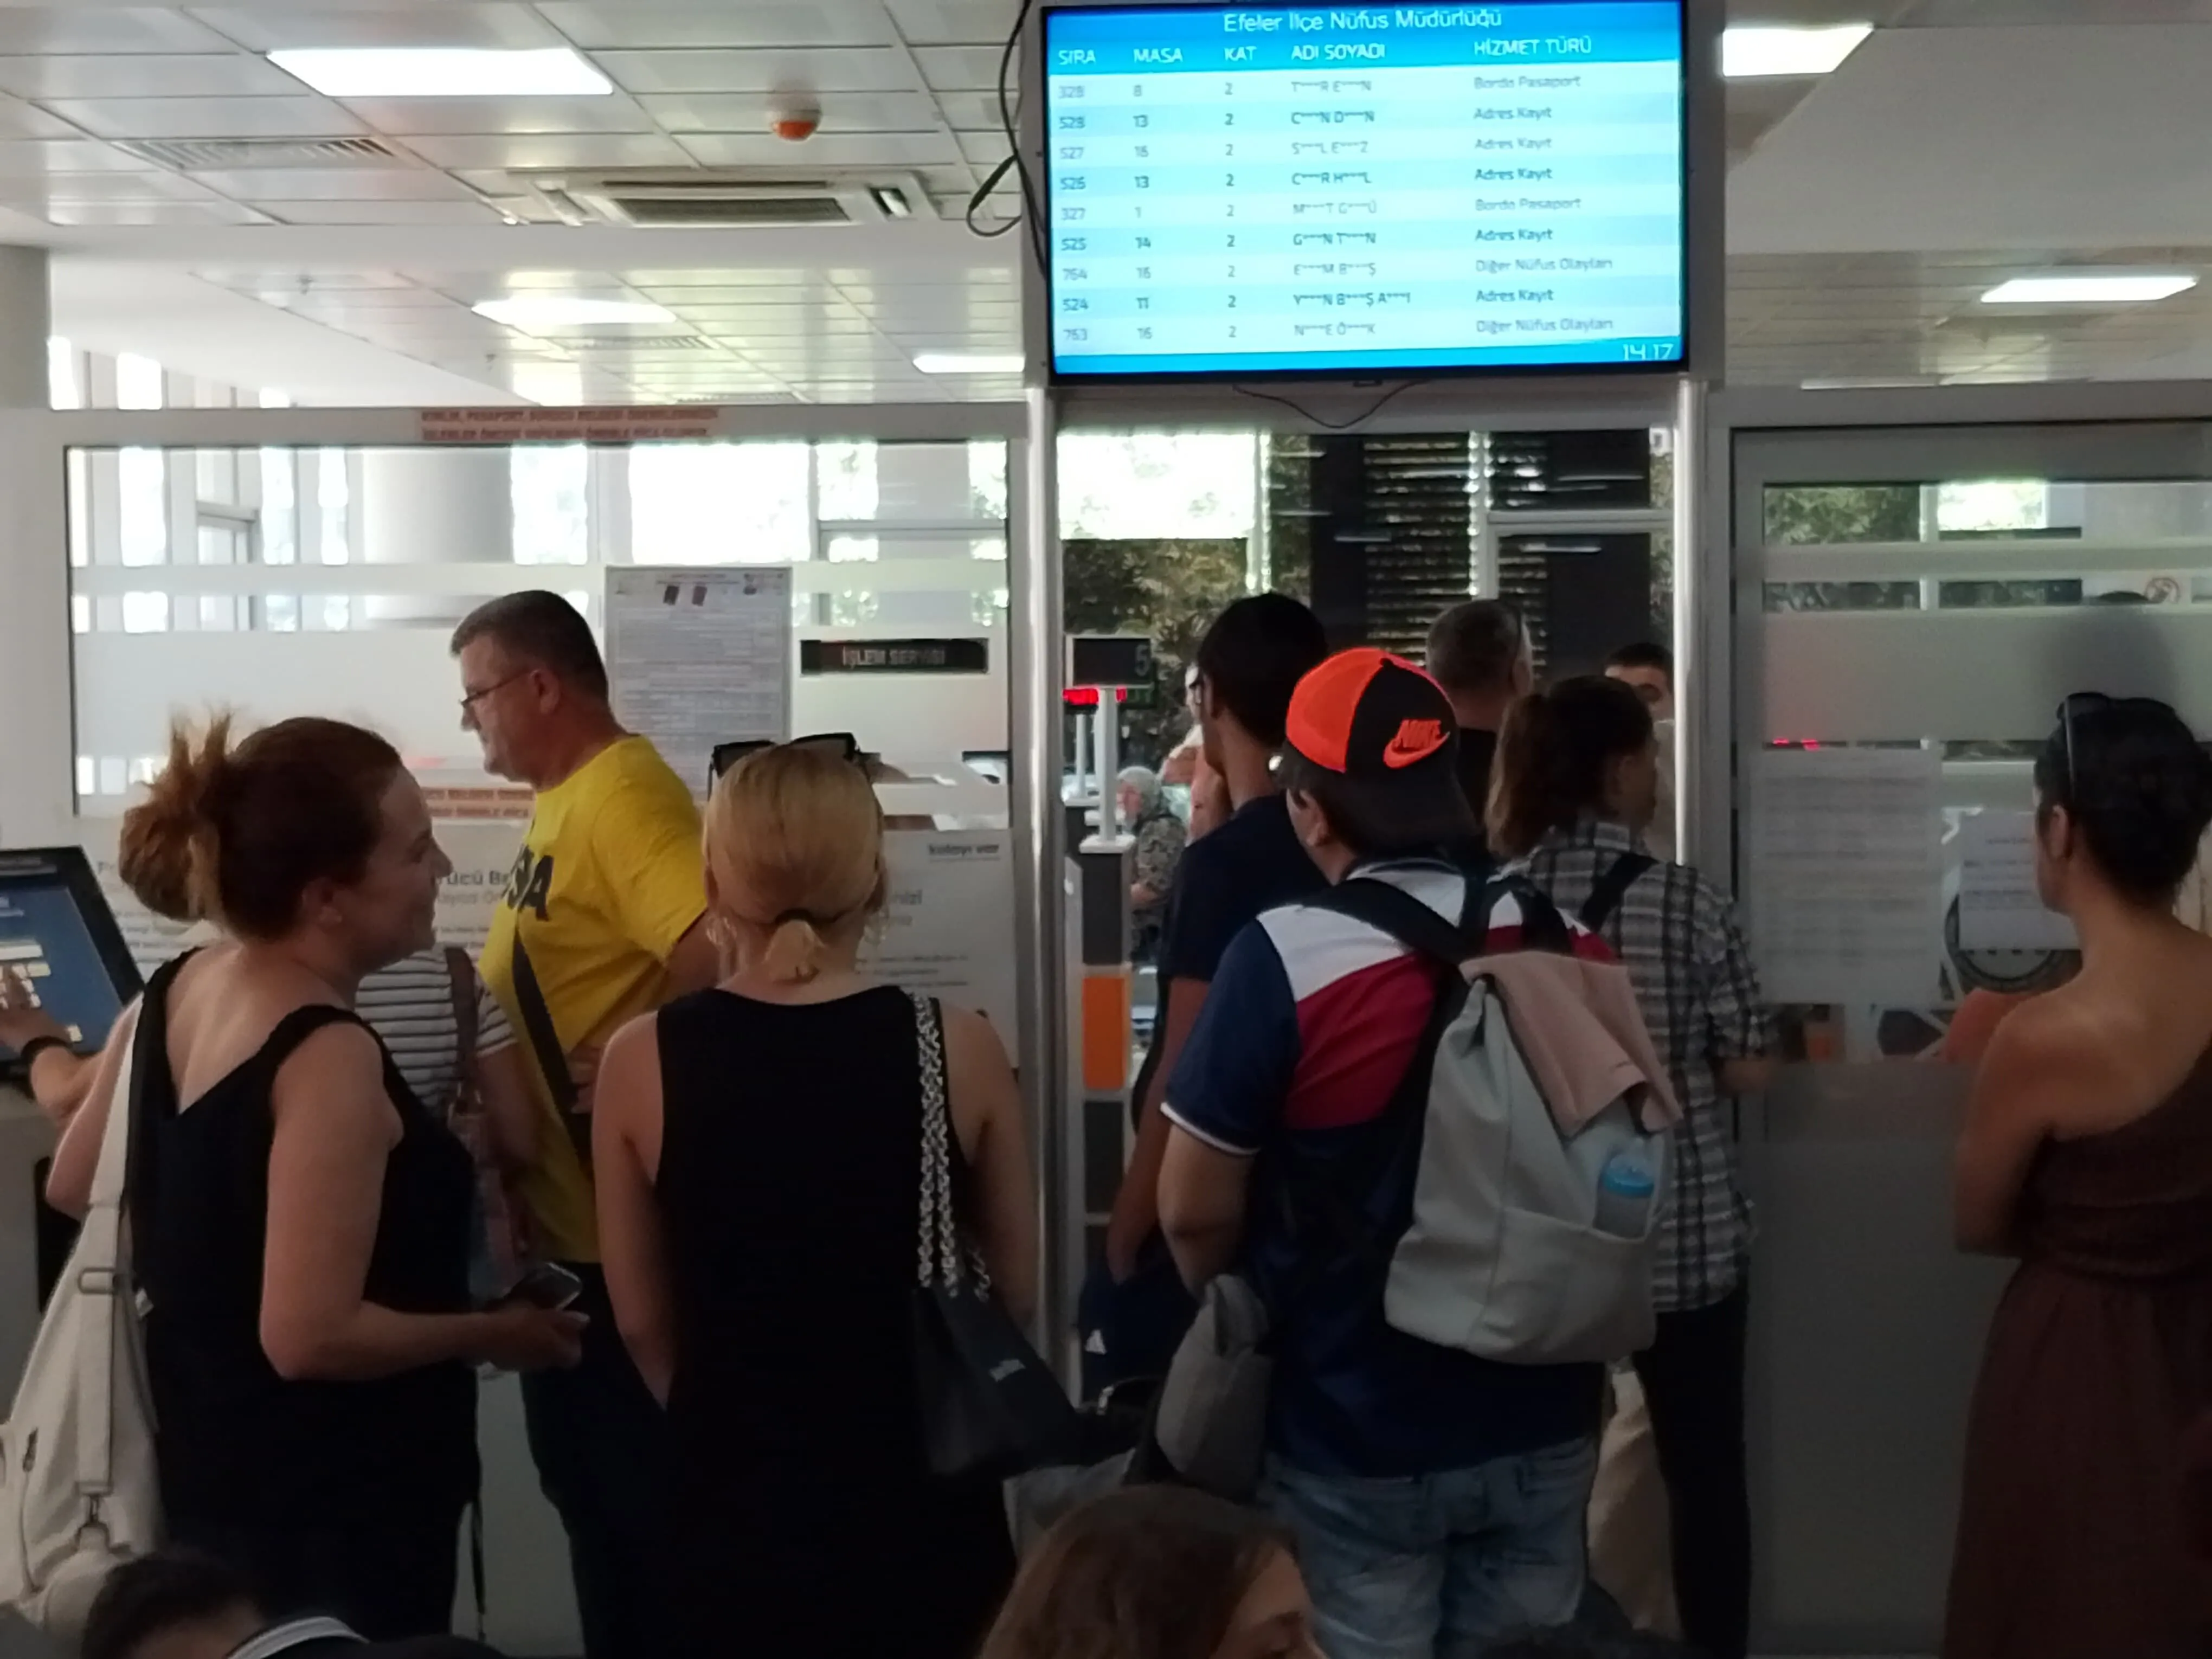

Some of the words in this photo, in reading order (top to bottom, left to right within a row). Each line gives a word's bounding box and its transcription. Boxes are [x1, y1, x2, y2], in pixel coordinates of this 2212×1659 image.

[1224, 12, 1282, 32] Efeler
[1331, 10, 1388, 29] Nüfus
[1395, 9, 1502, 28] Müdürlüğü
[1058, 49, 1096, 65] SIRA
[1134, 48, 1183, 63] MASA
[1225, 46, 1257, 61] KAT
[1291, 45, 1319, 60] ADI
[1324, 43, 1385, 60] SOYADI
[1545, 35, 1592, 54] TÜRÜ
[1225, 82, 1233, 95] 2
[1519, 75, 1581, 88] Pasaport
[1133, 114, 1149, 128] 13
[1225, 113, 1234, 126] 2
[1473, 108, 1515, 120] Adres
[1225, 143, 1233, 156] 2
[1474, 138, 1513, 150] Adres
[1135, 175, 1149, 188] 13
[1226, 173, 1234, 187] 2
[1474, 169, 1514, 180] Adres
[1135, 206, 1141, 218] 1
[1227, 204, 1234, 217] 2
[1519, 197, 1581, 211] Pasaport
[1227, 234, 1235, 247] 2
[1475, 229, 1515, 241] Adres
[1227, 265, 1235, 278] 2
[1515, 258, 1556, 271] Nüfus
[1136, 297, 1149, 309] 11
[1227, 295, 1236, 308] 2
[1476, 290, 1515, 302] Adres
[1228, 325, 1237, 338] 2
[1515, 319, 1557, 331] Nüfus
[1396, 719, 1442, 749] NIKE
